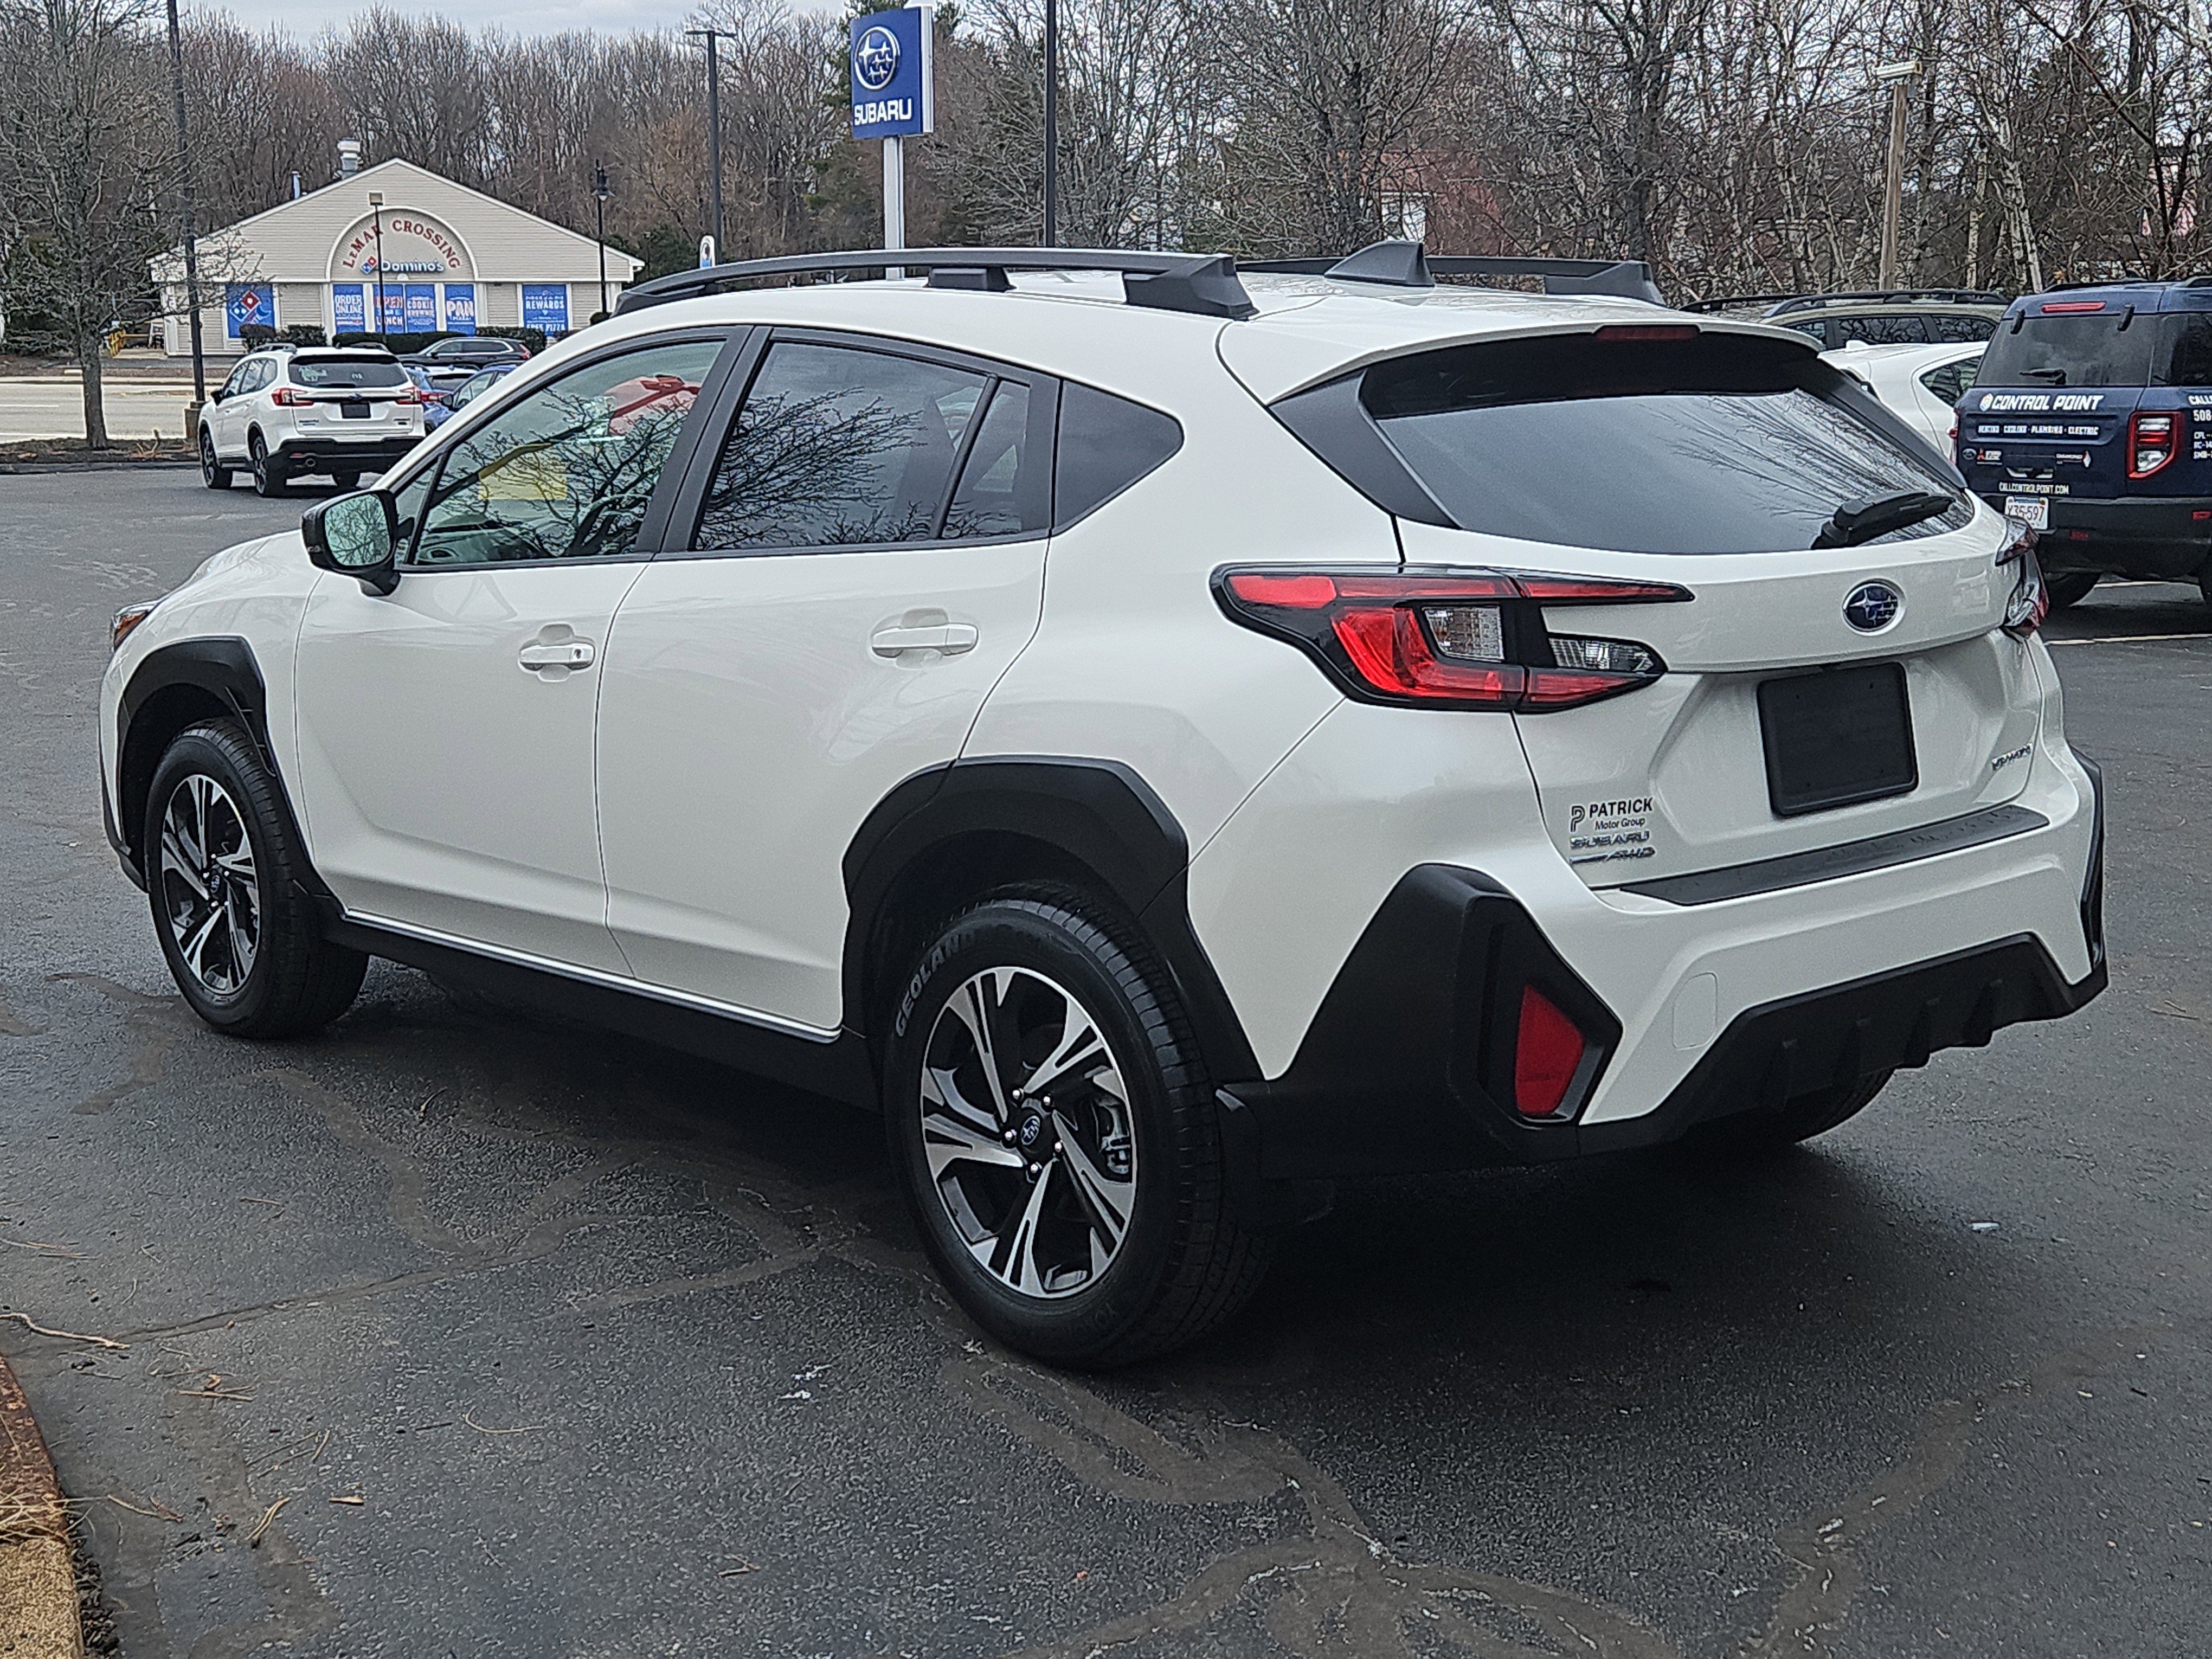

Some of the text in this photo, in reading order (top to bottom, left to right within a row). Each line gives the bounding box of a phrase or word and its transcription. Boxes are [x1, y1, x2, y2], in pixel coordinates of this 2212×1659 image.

[854, 98, 912, 126] SUBARU
[392, 219, 460, 269] CROSSING
[381, 259, 445, 272] Domino's
[335, 294, 362, 304] ORDER
[407, 300, 434, 310] COOKIE
[525, 300, 564, 310] REWARDS
[336, 304, 363, 314] ONLINE
[446, 301, 474, 317] PAN
[1992, 395, 2104, 410] CONTROL POINT
[1589, 797, 1653, 818] PATRICK
[1595, 817, 1646, 831] Motor Group
[1570, 831, 1650, 848] SUBARU
